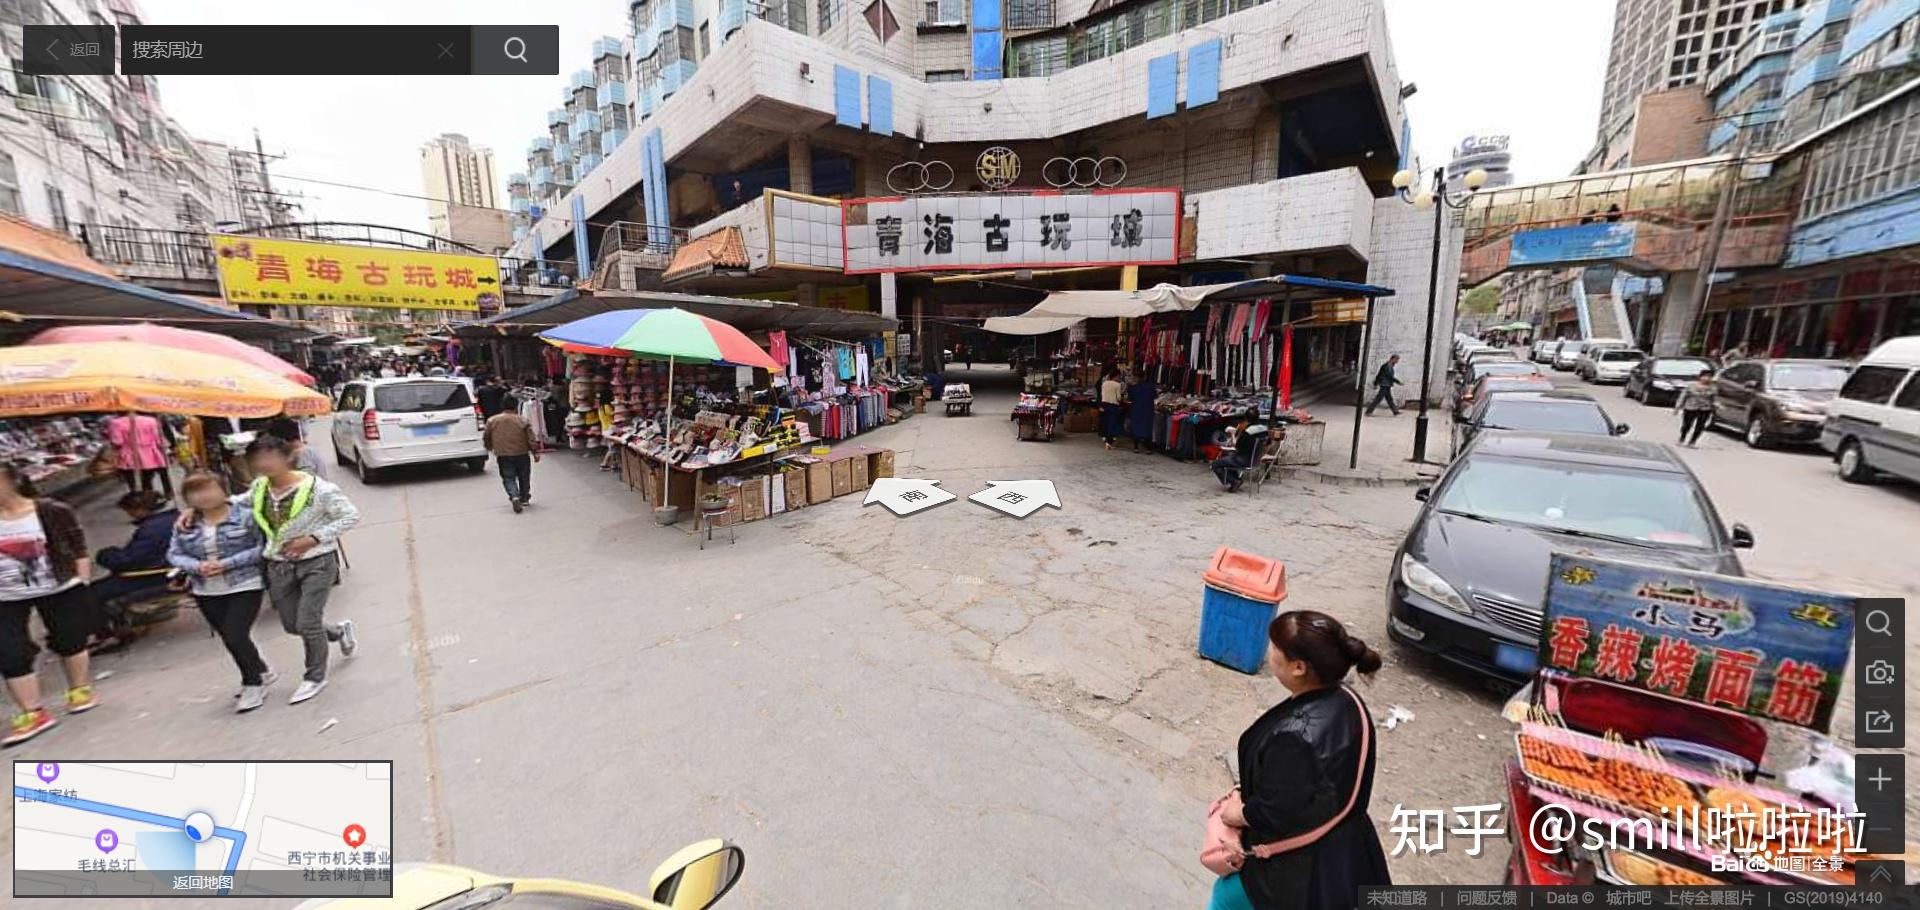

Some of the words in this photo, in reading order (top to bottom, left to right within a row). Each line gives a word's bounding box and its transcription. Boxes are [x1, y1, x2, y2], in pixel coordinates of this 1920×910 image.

[876, 207, 1144, 257] 青海古玩城
[256, 250, 477, 291] 青海古玩城
[1635, 603, 1724, 639] 小马
[1549, 615, 1827, 726] 香辣烤面筋
